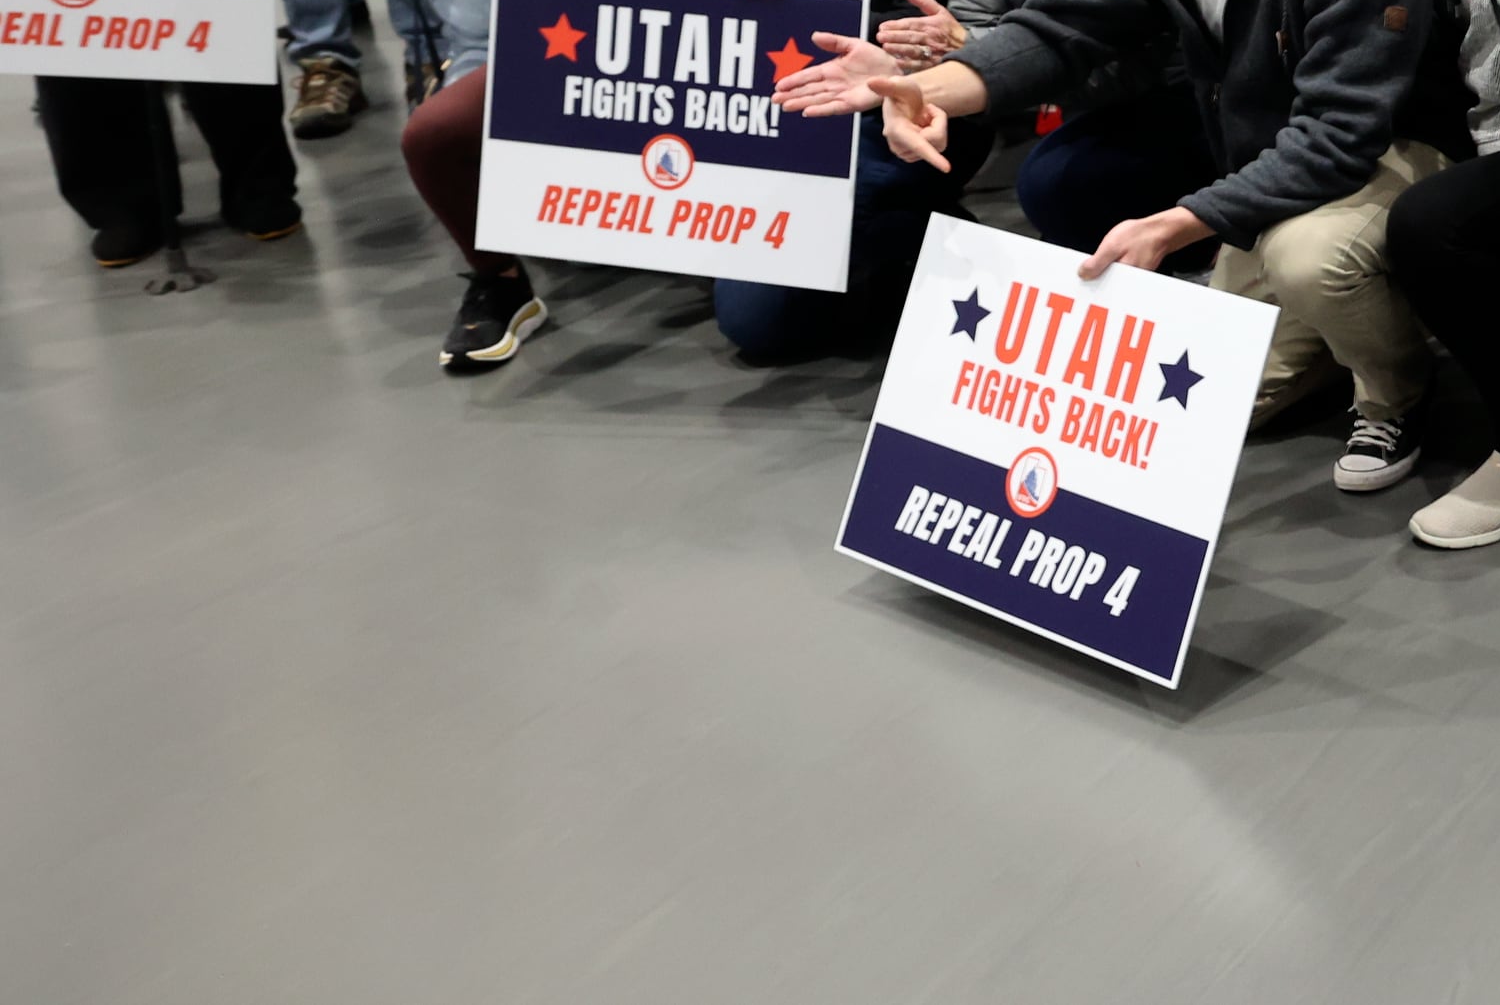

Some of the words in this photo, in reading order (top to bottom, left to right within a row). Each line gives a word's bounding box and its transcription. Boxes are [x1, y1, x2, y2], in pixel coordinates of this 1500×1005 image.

[0, 11, 64, 48] EAL
[79, 15, 177, 51] PROP
[186, 20, 212, 53] 4
[595, 4, 758, 89] UTAH
[563, 75, 675, 126] FIGHTS
[684, 88, 781, 138] BACK!
[536, 184, 656, 235] REPEAL
[666, 198, 758, 245] PROP
[763, 210, 791, 250] 4
[994, 280, 1157, 405] UTAH
[951, 359, 1057, 435] FIGHTS
[1059, 394, 1160, 471] BACK!
[894, 485, 1013, 569] REPEAL
[1009, 528, 1107, 601] PROP
[1102, 565, 1141, 617] 4
